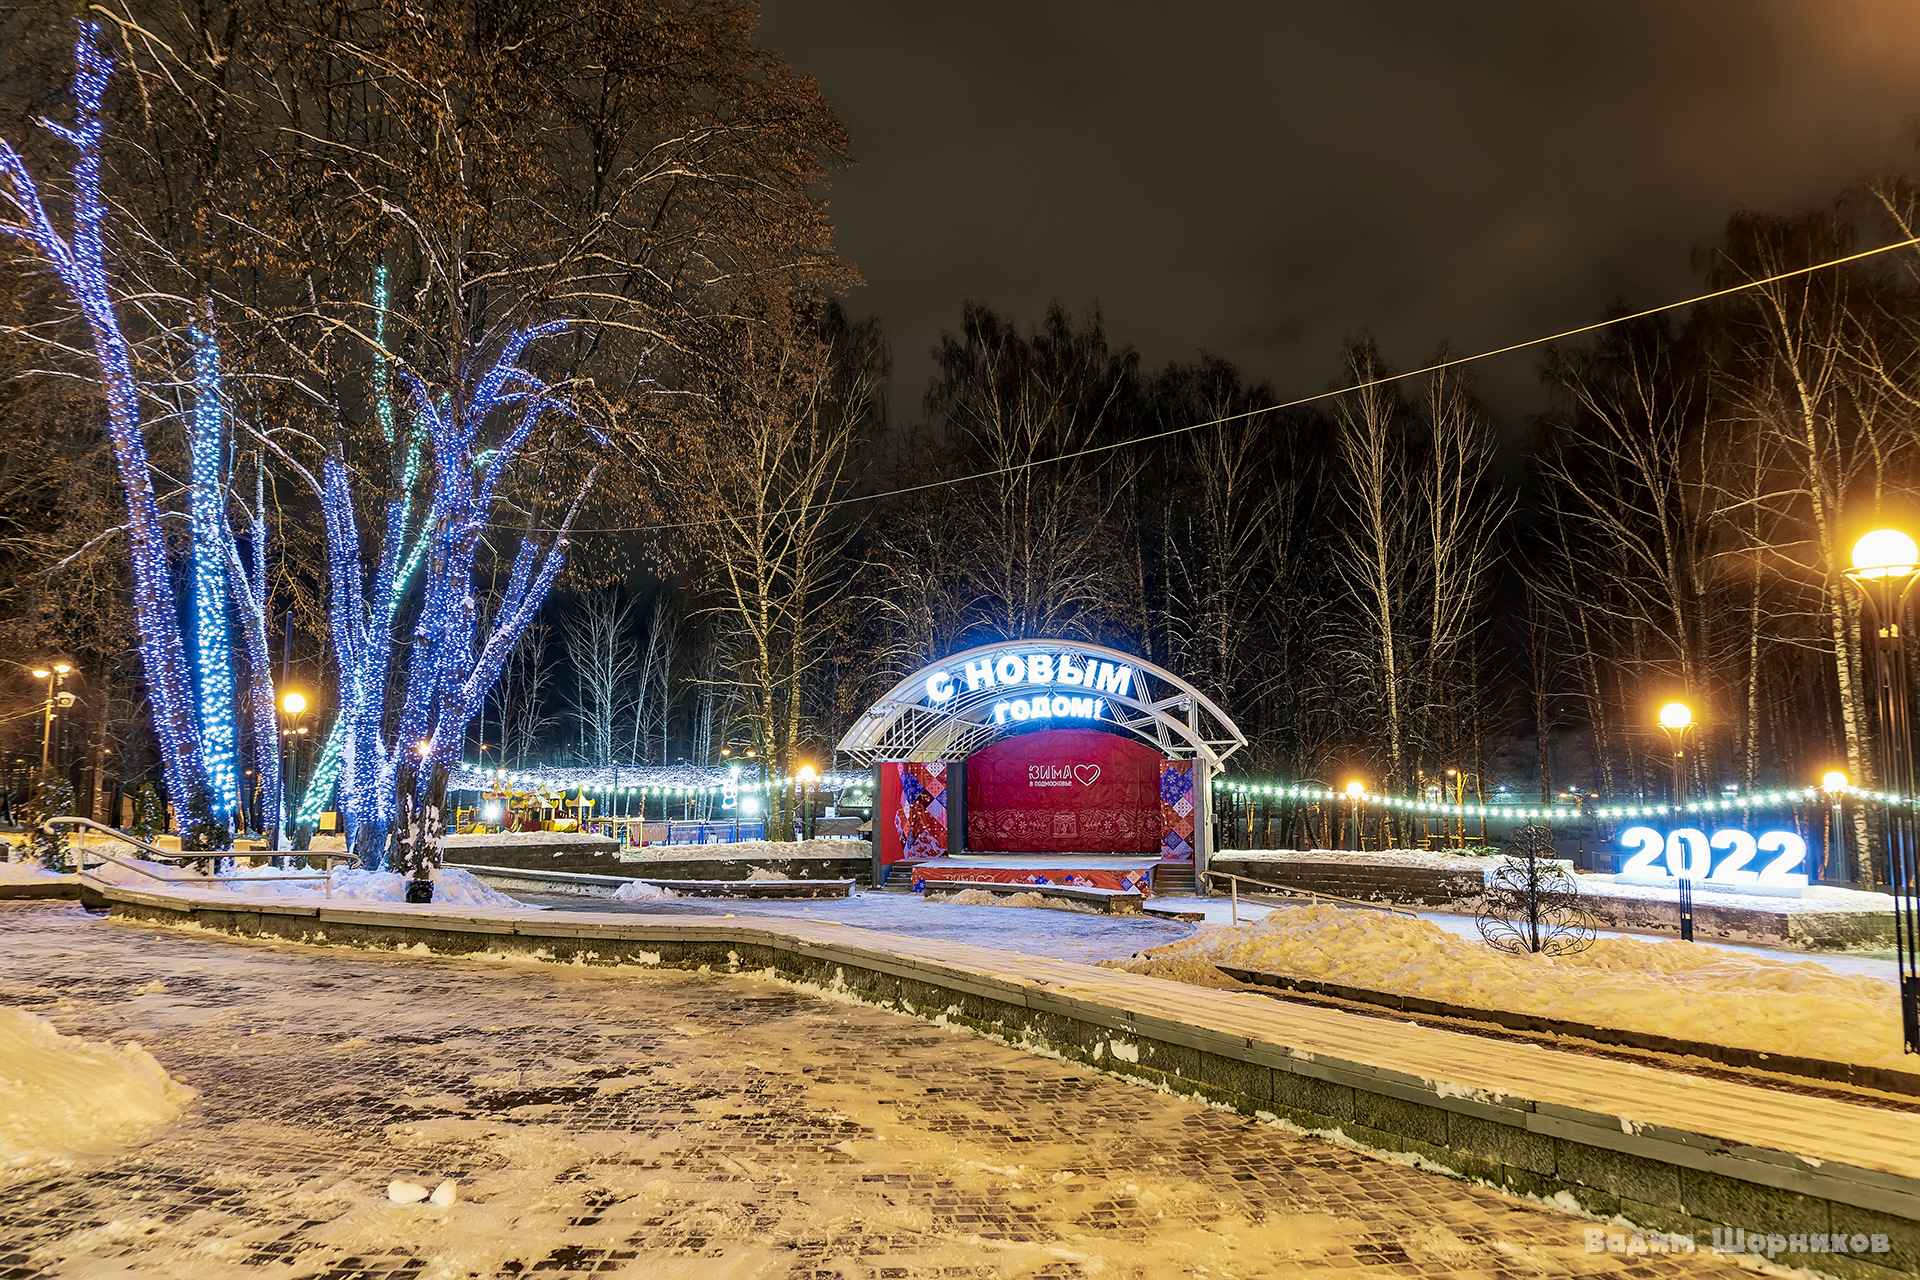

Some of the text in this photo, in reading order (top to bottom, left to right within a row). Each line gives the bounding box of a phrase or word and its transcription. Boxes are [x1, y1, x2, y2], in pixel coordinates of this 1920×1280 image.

[926, 654, 1132, 702] С НОВЫМ
[1028, 765, 1073, 780] ЗИМА
[1621, 826, 1809, 888] 2022
